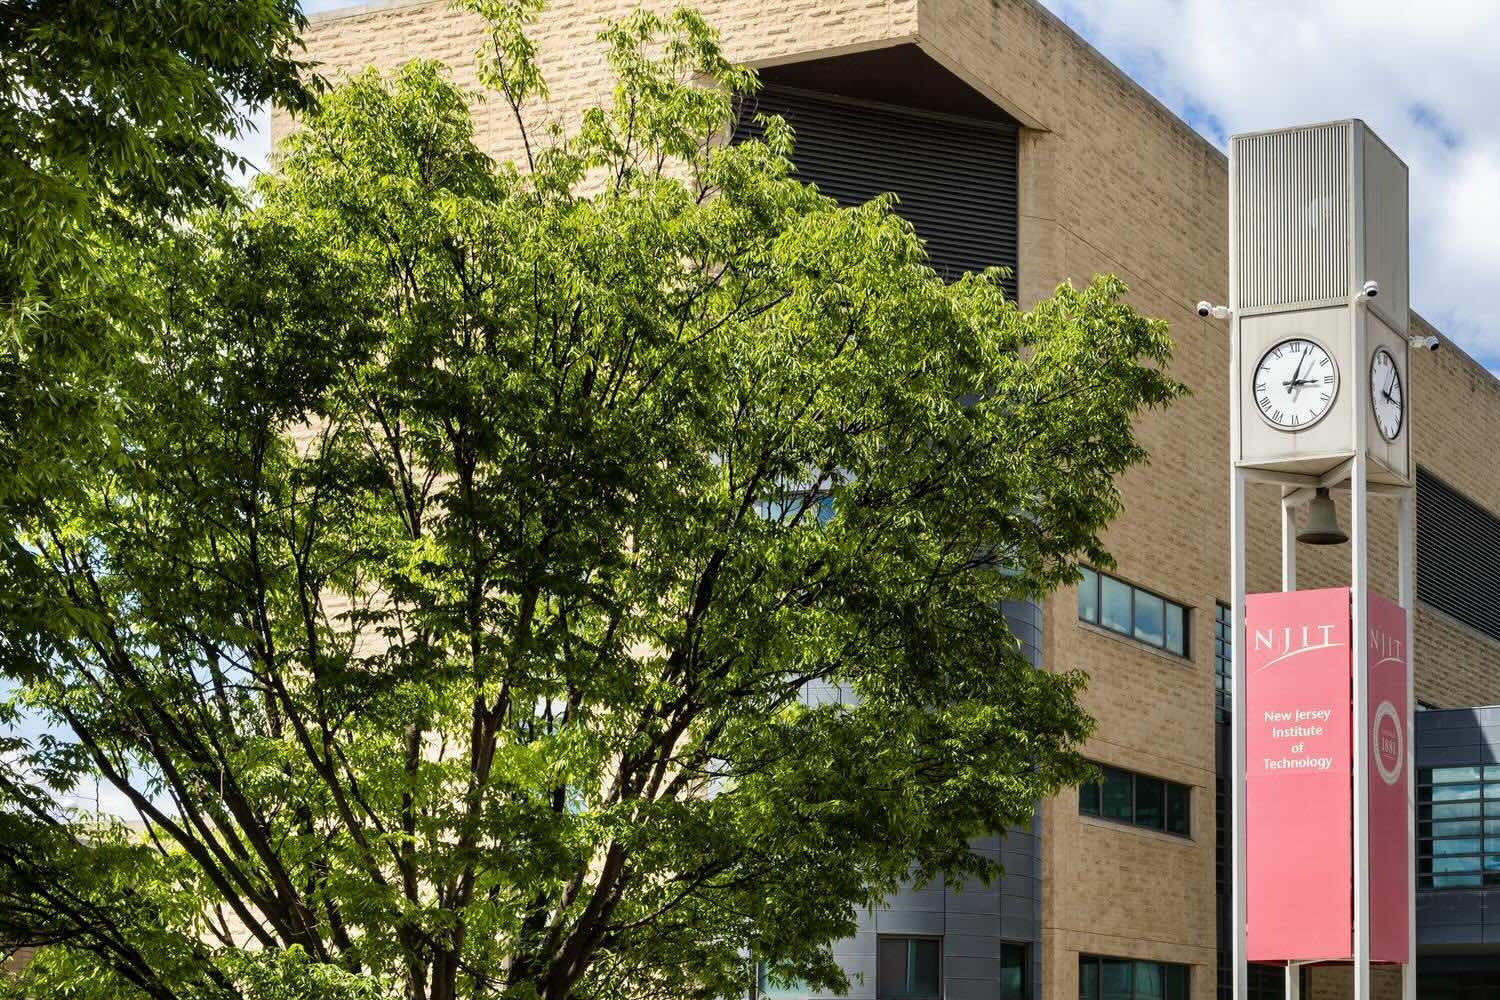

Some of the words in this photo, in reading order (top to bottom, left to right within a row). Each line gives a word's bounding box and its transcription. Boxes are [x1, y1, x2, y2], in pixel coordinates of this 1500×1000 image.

[1255, 624, 1335, 655] NJIT
[1263, 711, 1292, 723] New
[1295, 709, 1332, 723] Jersey
[1272, 726, 1323, 739] Institute
[1291, 743, 1305, 754] of
[1263, 757, 1333, 770] Technology
